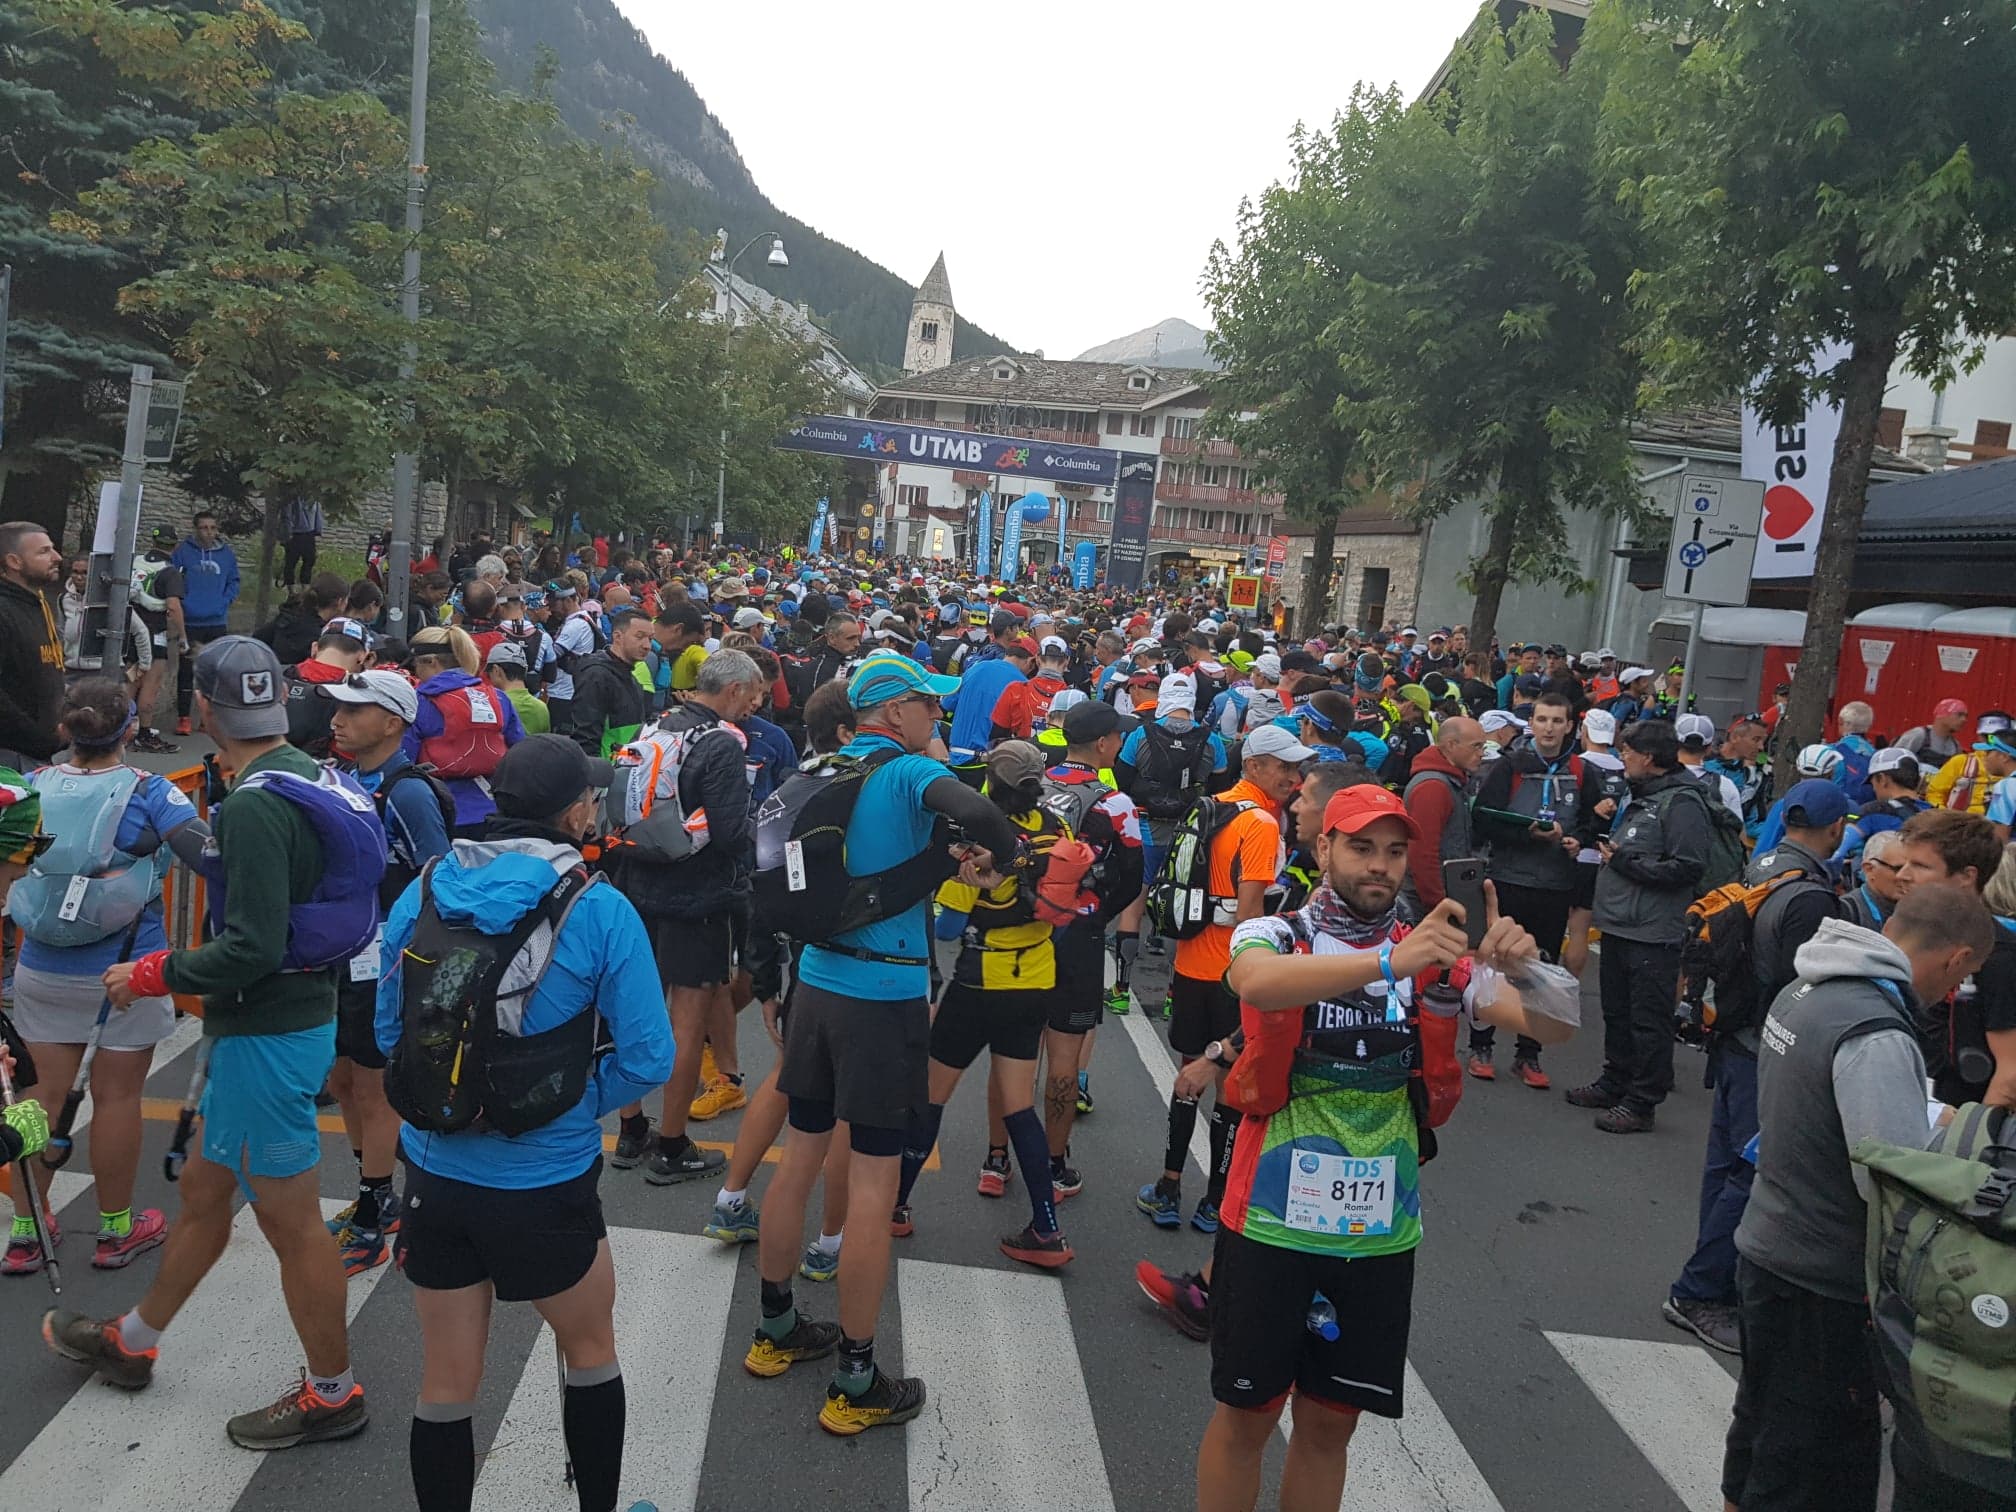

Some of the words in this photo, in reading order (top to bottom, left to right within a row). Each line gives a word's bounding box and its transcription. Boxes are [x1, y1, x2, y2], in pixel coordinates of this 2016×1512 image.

[801, 426, 848, 442] Columbia
[909, 433, 983, 463] UTMB
[1054, 456, 1101, 472] Columbia
[1005, 510, 1020, 560] Columbia
[1317, 1000, 1362, 1029] TEROR
[1219, 1123, 1236, 1174] BOOSTER
[1342, 1160, 1381, 1178] TDS
[1331, 1180, 1385, 1202] 8171
[1344, 1203, 1374, 1212] Roman
